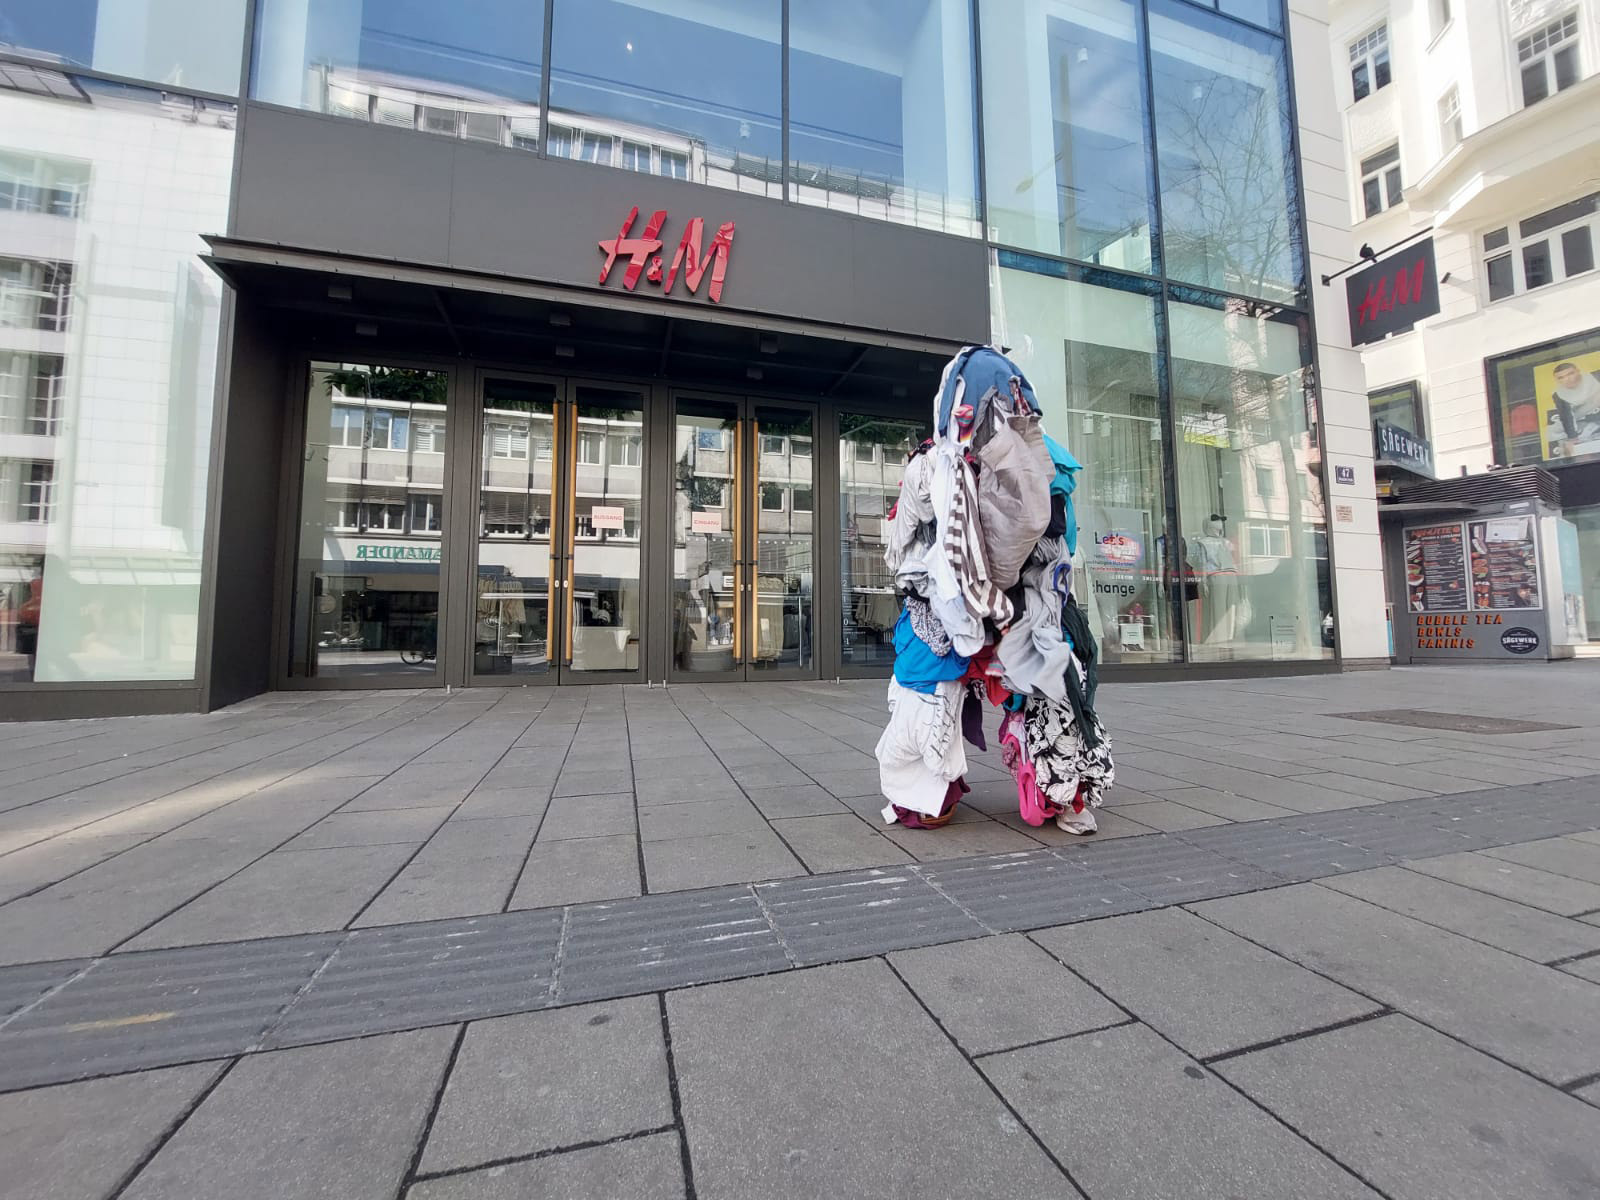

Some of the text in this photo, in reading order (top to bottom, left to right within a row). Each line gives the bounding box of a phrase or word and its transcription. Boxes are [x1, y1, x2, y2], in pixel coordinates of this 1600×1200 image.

[598, 206, 735, 303] H&M
[1356, 256, 1425, 328] H&M
[1095, 531, 1124, 546] Let's
[1416, 613, 1503, 626] BUBBLE TEA
[1417, 627, 1462, 638] BOWLS
[1417, 639, 1475, 649] PANINIS
